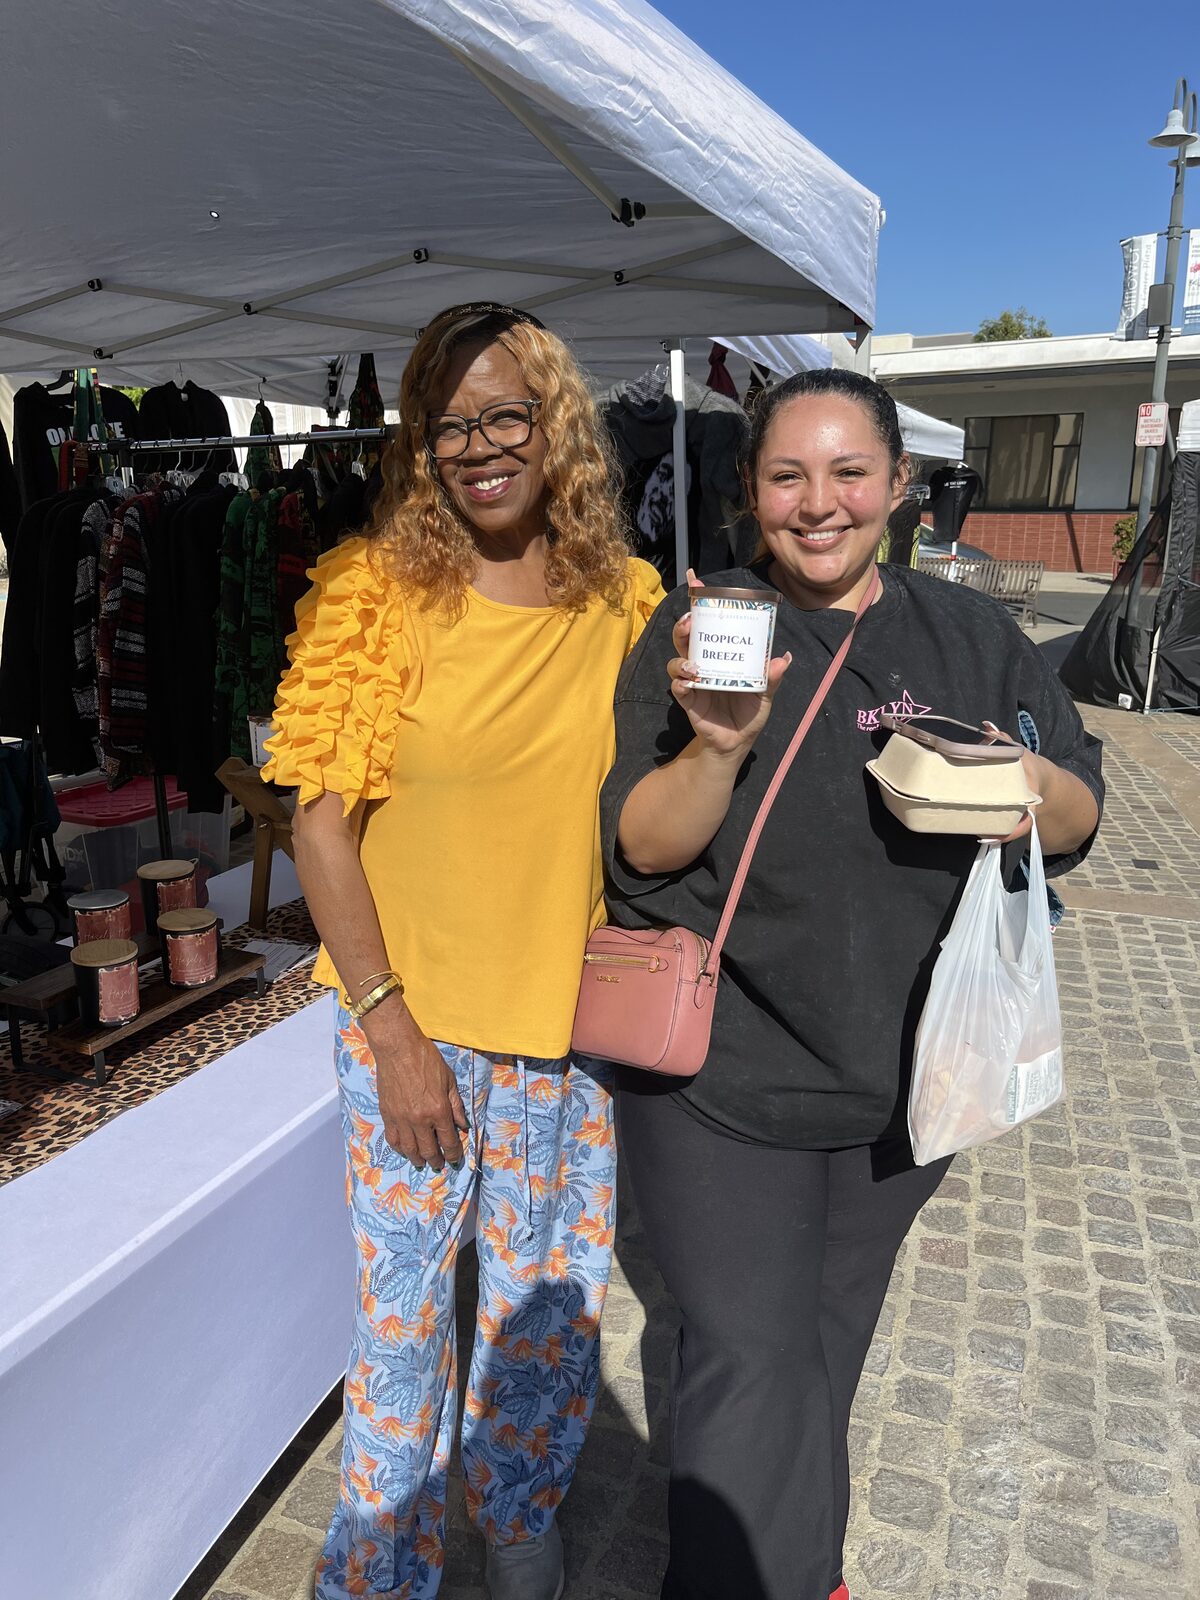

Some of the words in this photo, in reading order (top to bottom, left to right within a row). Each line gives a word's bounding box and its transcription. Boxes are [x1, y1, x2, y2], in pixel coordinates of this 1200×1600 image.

[1140, 405, 1151, 416] NO
[698, 631, 754, 646] TROPICAL
[702, 649, 745, 662] BREEZE
